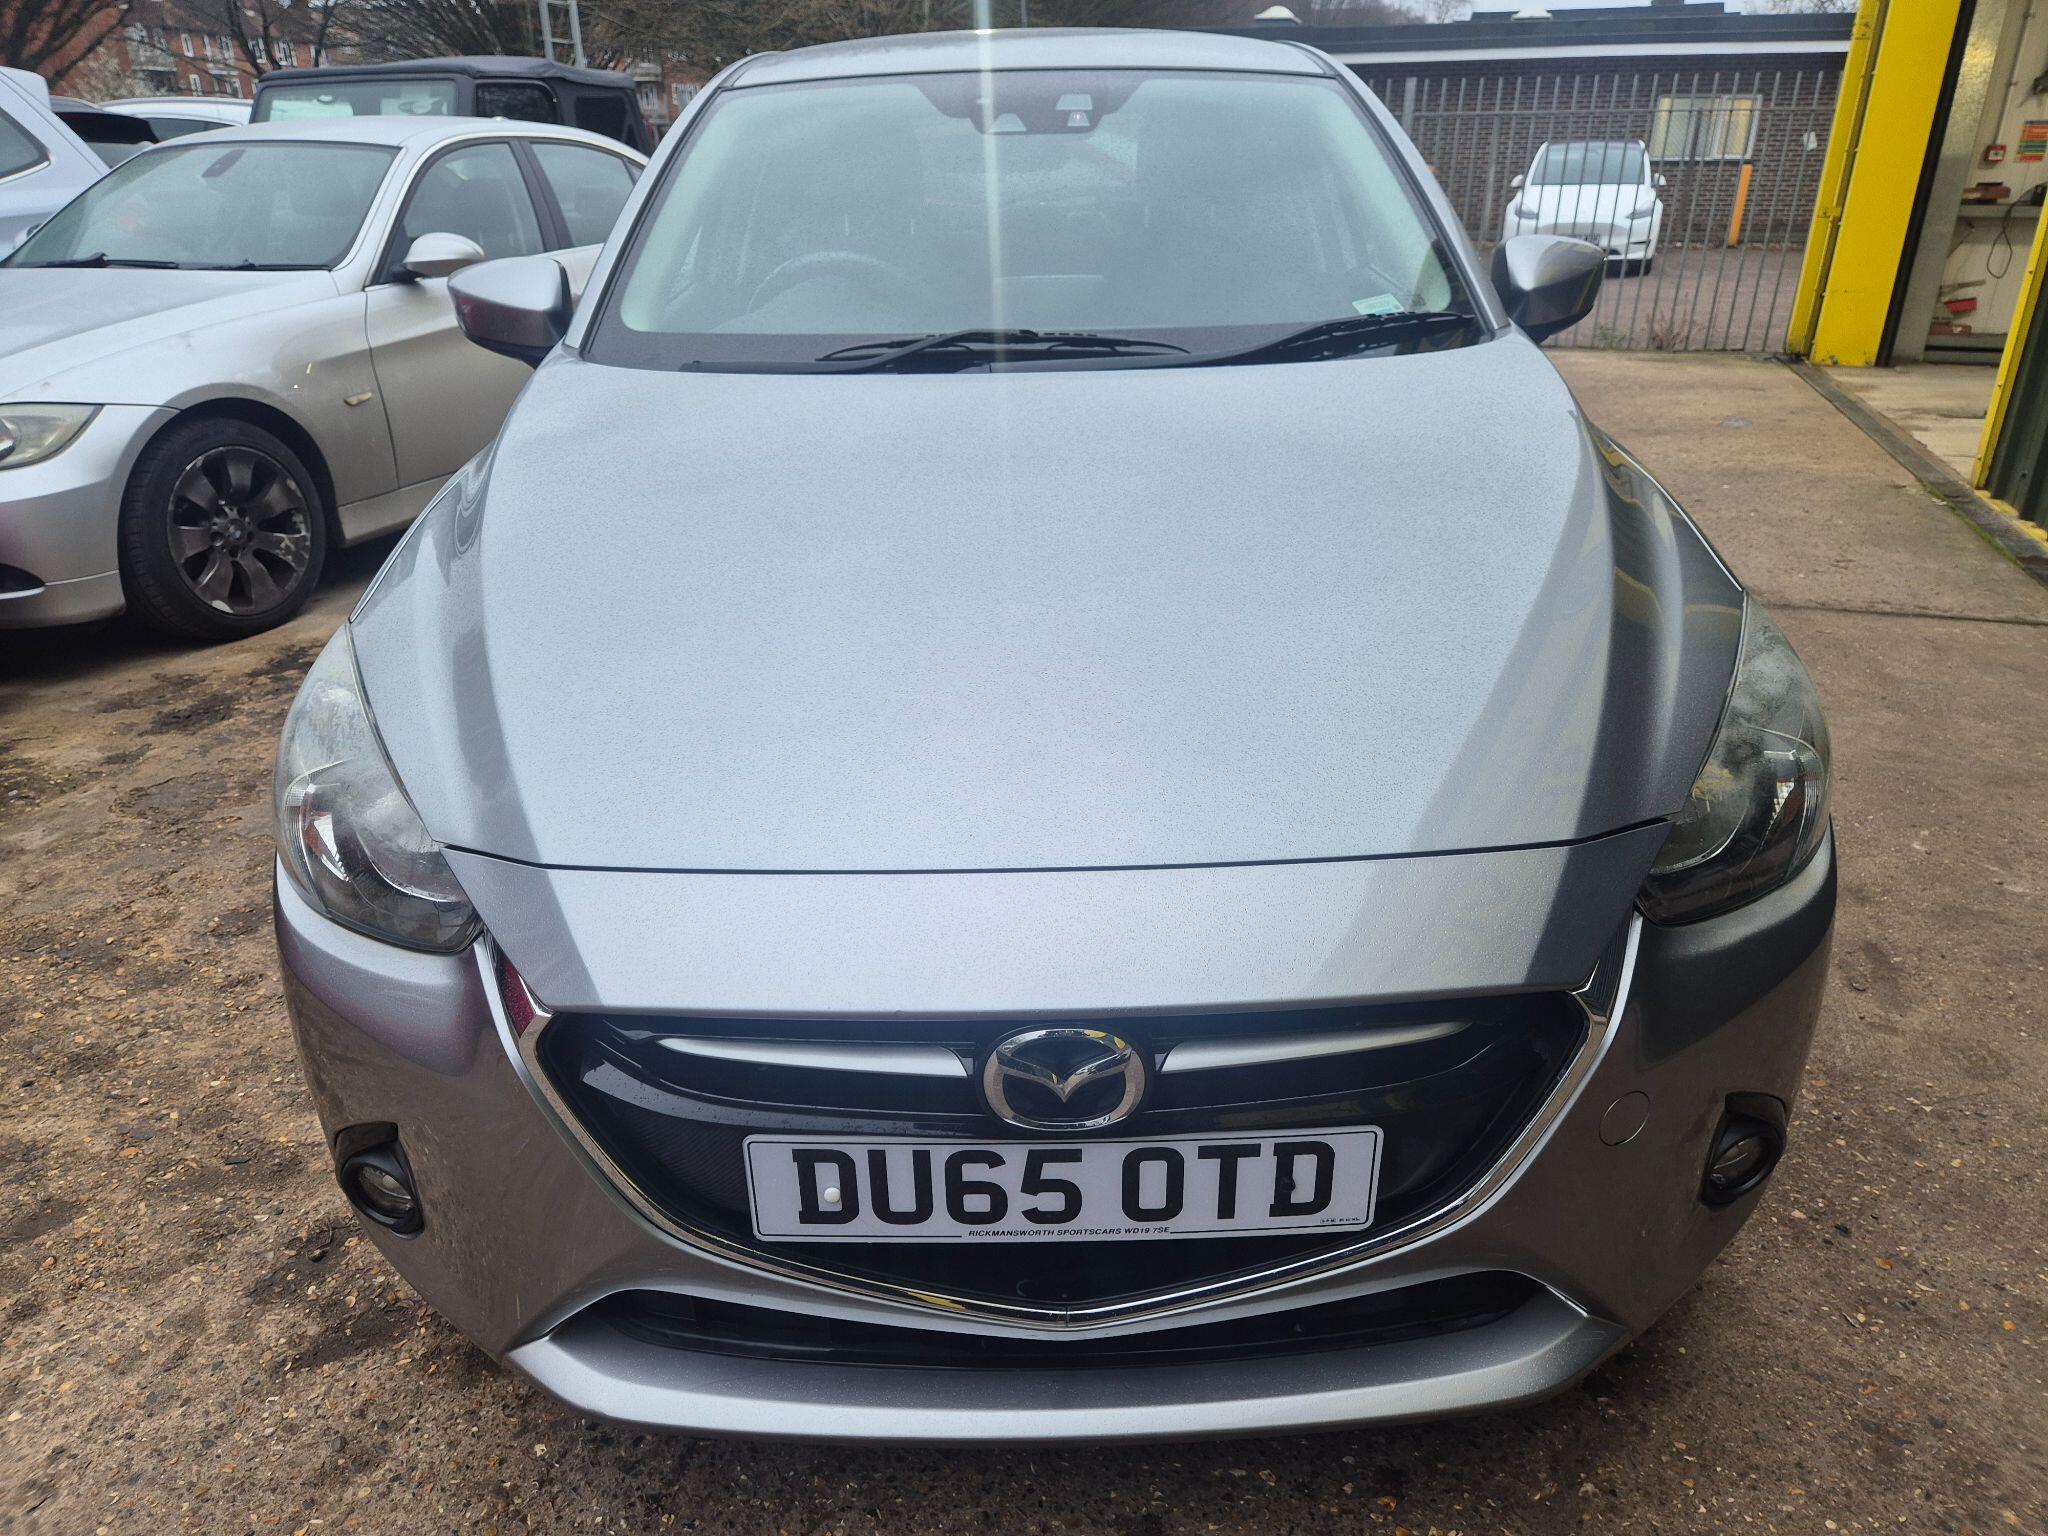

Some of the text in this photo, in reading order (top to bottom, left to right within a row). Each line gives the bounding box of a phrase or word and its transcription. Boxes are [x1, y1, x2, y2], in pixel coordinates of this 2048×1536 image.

[791, 1141, 1336, 1226] DU65 OTD
[968, 1226, 1171, 1238] RICKMANSWORTH SPORTSCARS WD19 7SE
